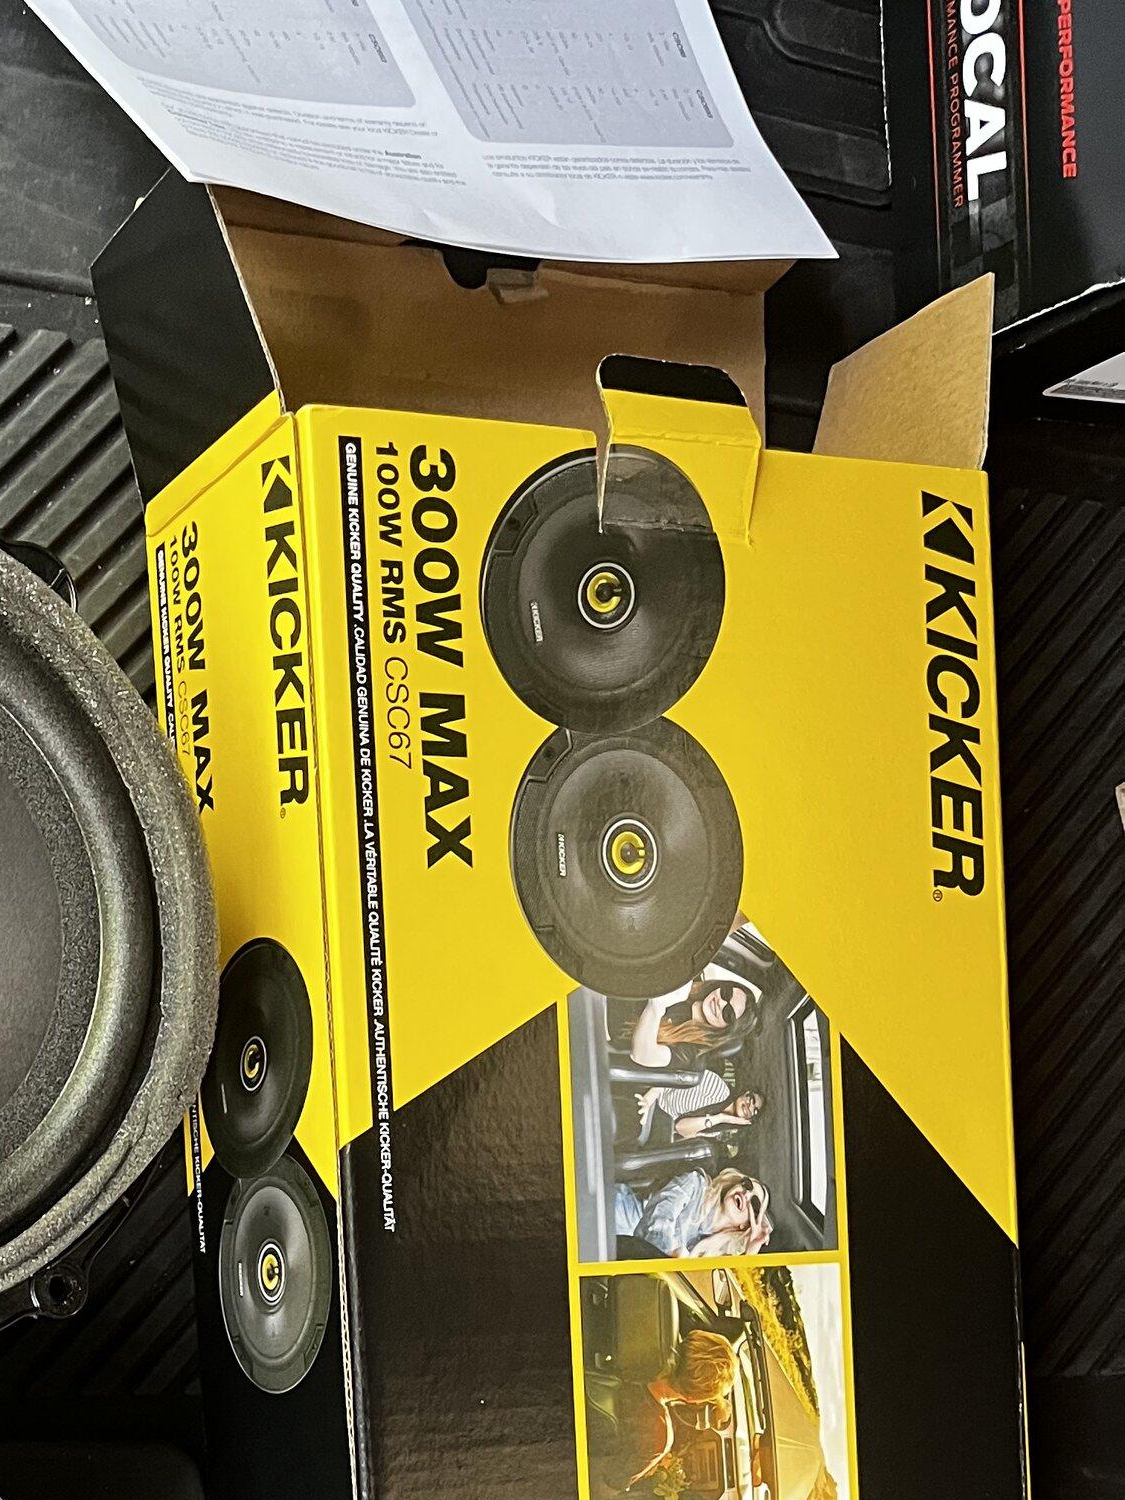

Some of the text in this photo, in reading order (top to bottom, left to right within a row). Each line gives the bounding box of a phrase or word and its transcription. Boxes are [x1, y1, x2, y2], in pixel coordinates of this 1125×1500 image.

[1057, 0, 1077, 178] PERFORMANCE
[949, 73, 964, 208] PROGRAMMER
[344, 442, 358, 506] GENUINE
[348, 508, 362, 561] KICKER
[158, 549, 167, 607] GENUINE
[351, 563, 365, 622] QUALITY
[376, 441, 412, 770] 100W RMS CSC67
[161, 607, 171, 655] KICKER
[170, 535, 190, 755] 100W RMS CSC67
[410, 445, 474, 870] 300W MAX
[164, 655, 173, 708] QUALITY
[181, 521, 214, 815] 300W MAX
[357, 686, 370, 745] GENUINA
[360, 748, 372, 766] DE
[361, 769, 374, 816] KICKER
[365, 841, 378, 909] VÉRITABLE
[557, 841, 567, 877] KICKER
[368, 911, 382, 966] QUALITÉ
[371, 968, 384, 1016] KICKER
[379, 1122, 396, 1232] KICKER-QUALITÄT
